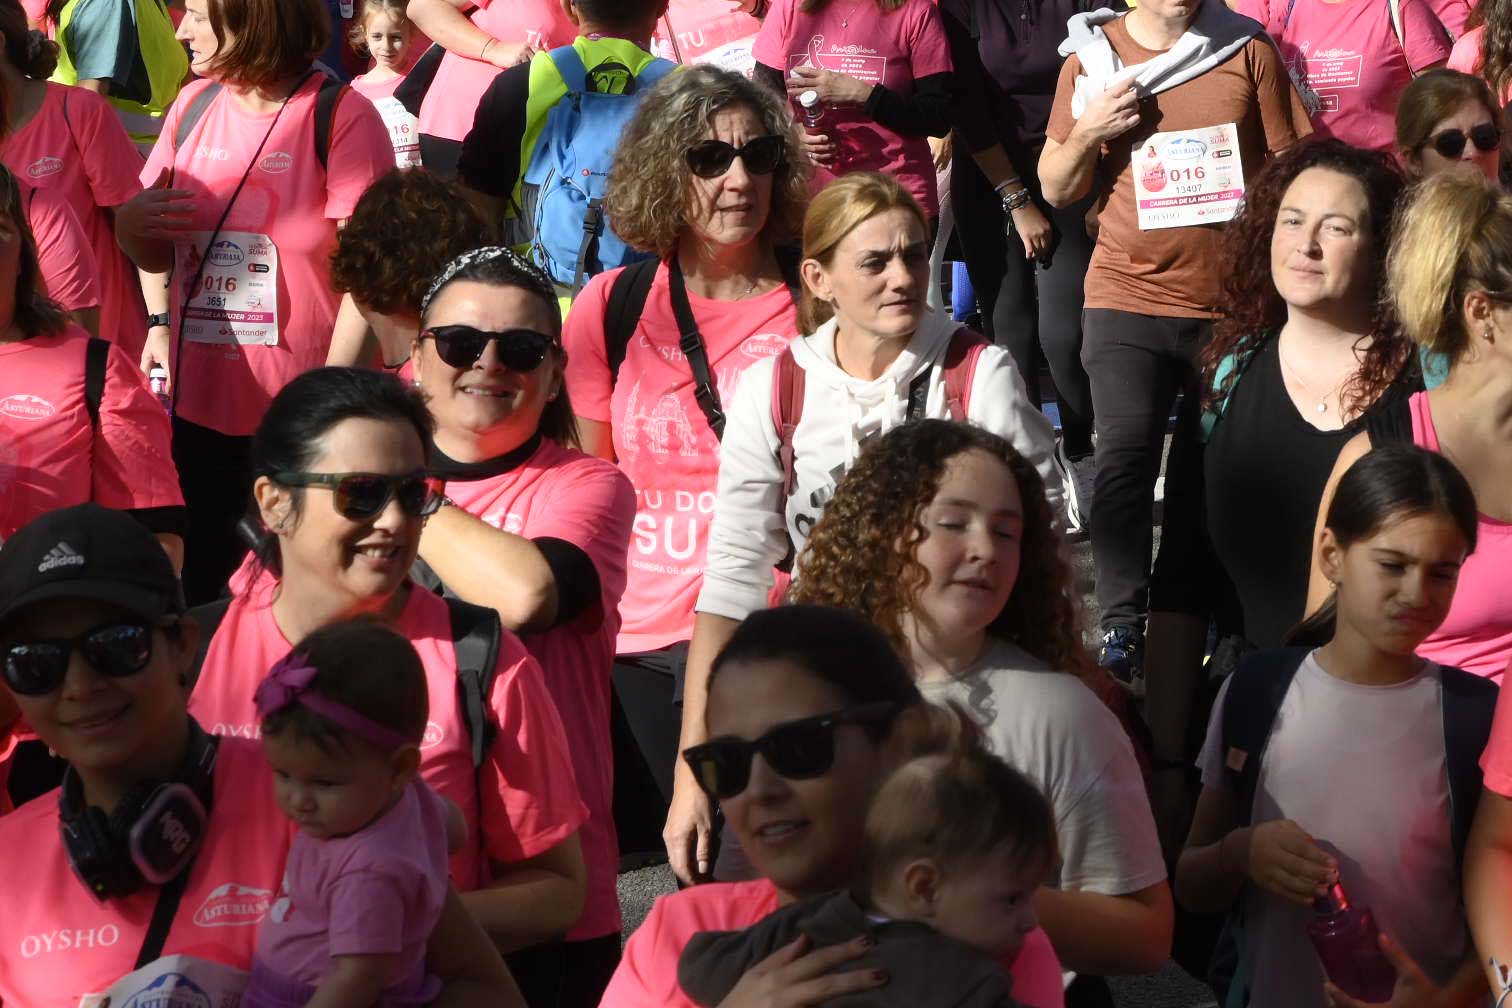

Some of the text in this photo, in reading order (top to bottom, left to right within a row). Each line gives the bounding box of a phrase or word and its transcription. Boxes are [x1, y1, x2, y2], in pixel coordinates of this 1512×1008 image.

[679, 29, 705, 50] TU
[1170, 166, 1206, 182] 016
[1149, 197, 1178, 208] CARRERA
[1178, 197, 1188, 205] DE
[1188, 195, 1198, 203] LA
[1198, 194, 1219, 203] MUJER
[205, 275, 237, 292] 016
[247, 312, 264, 321] 2023
[228, 328, 267, 337] Santander
[632, 513, 697, 560] SU
[38, 552, 85, 573] adidas
[20, 923, 120, 959] OYSHO
